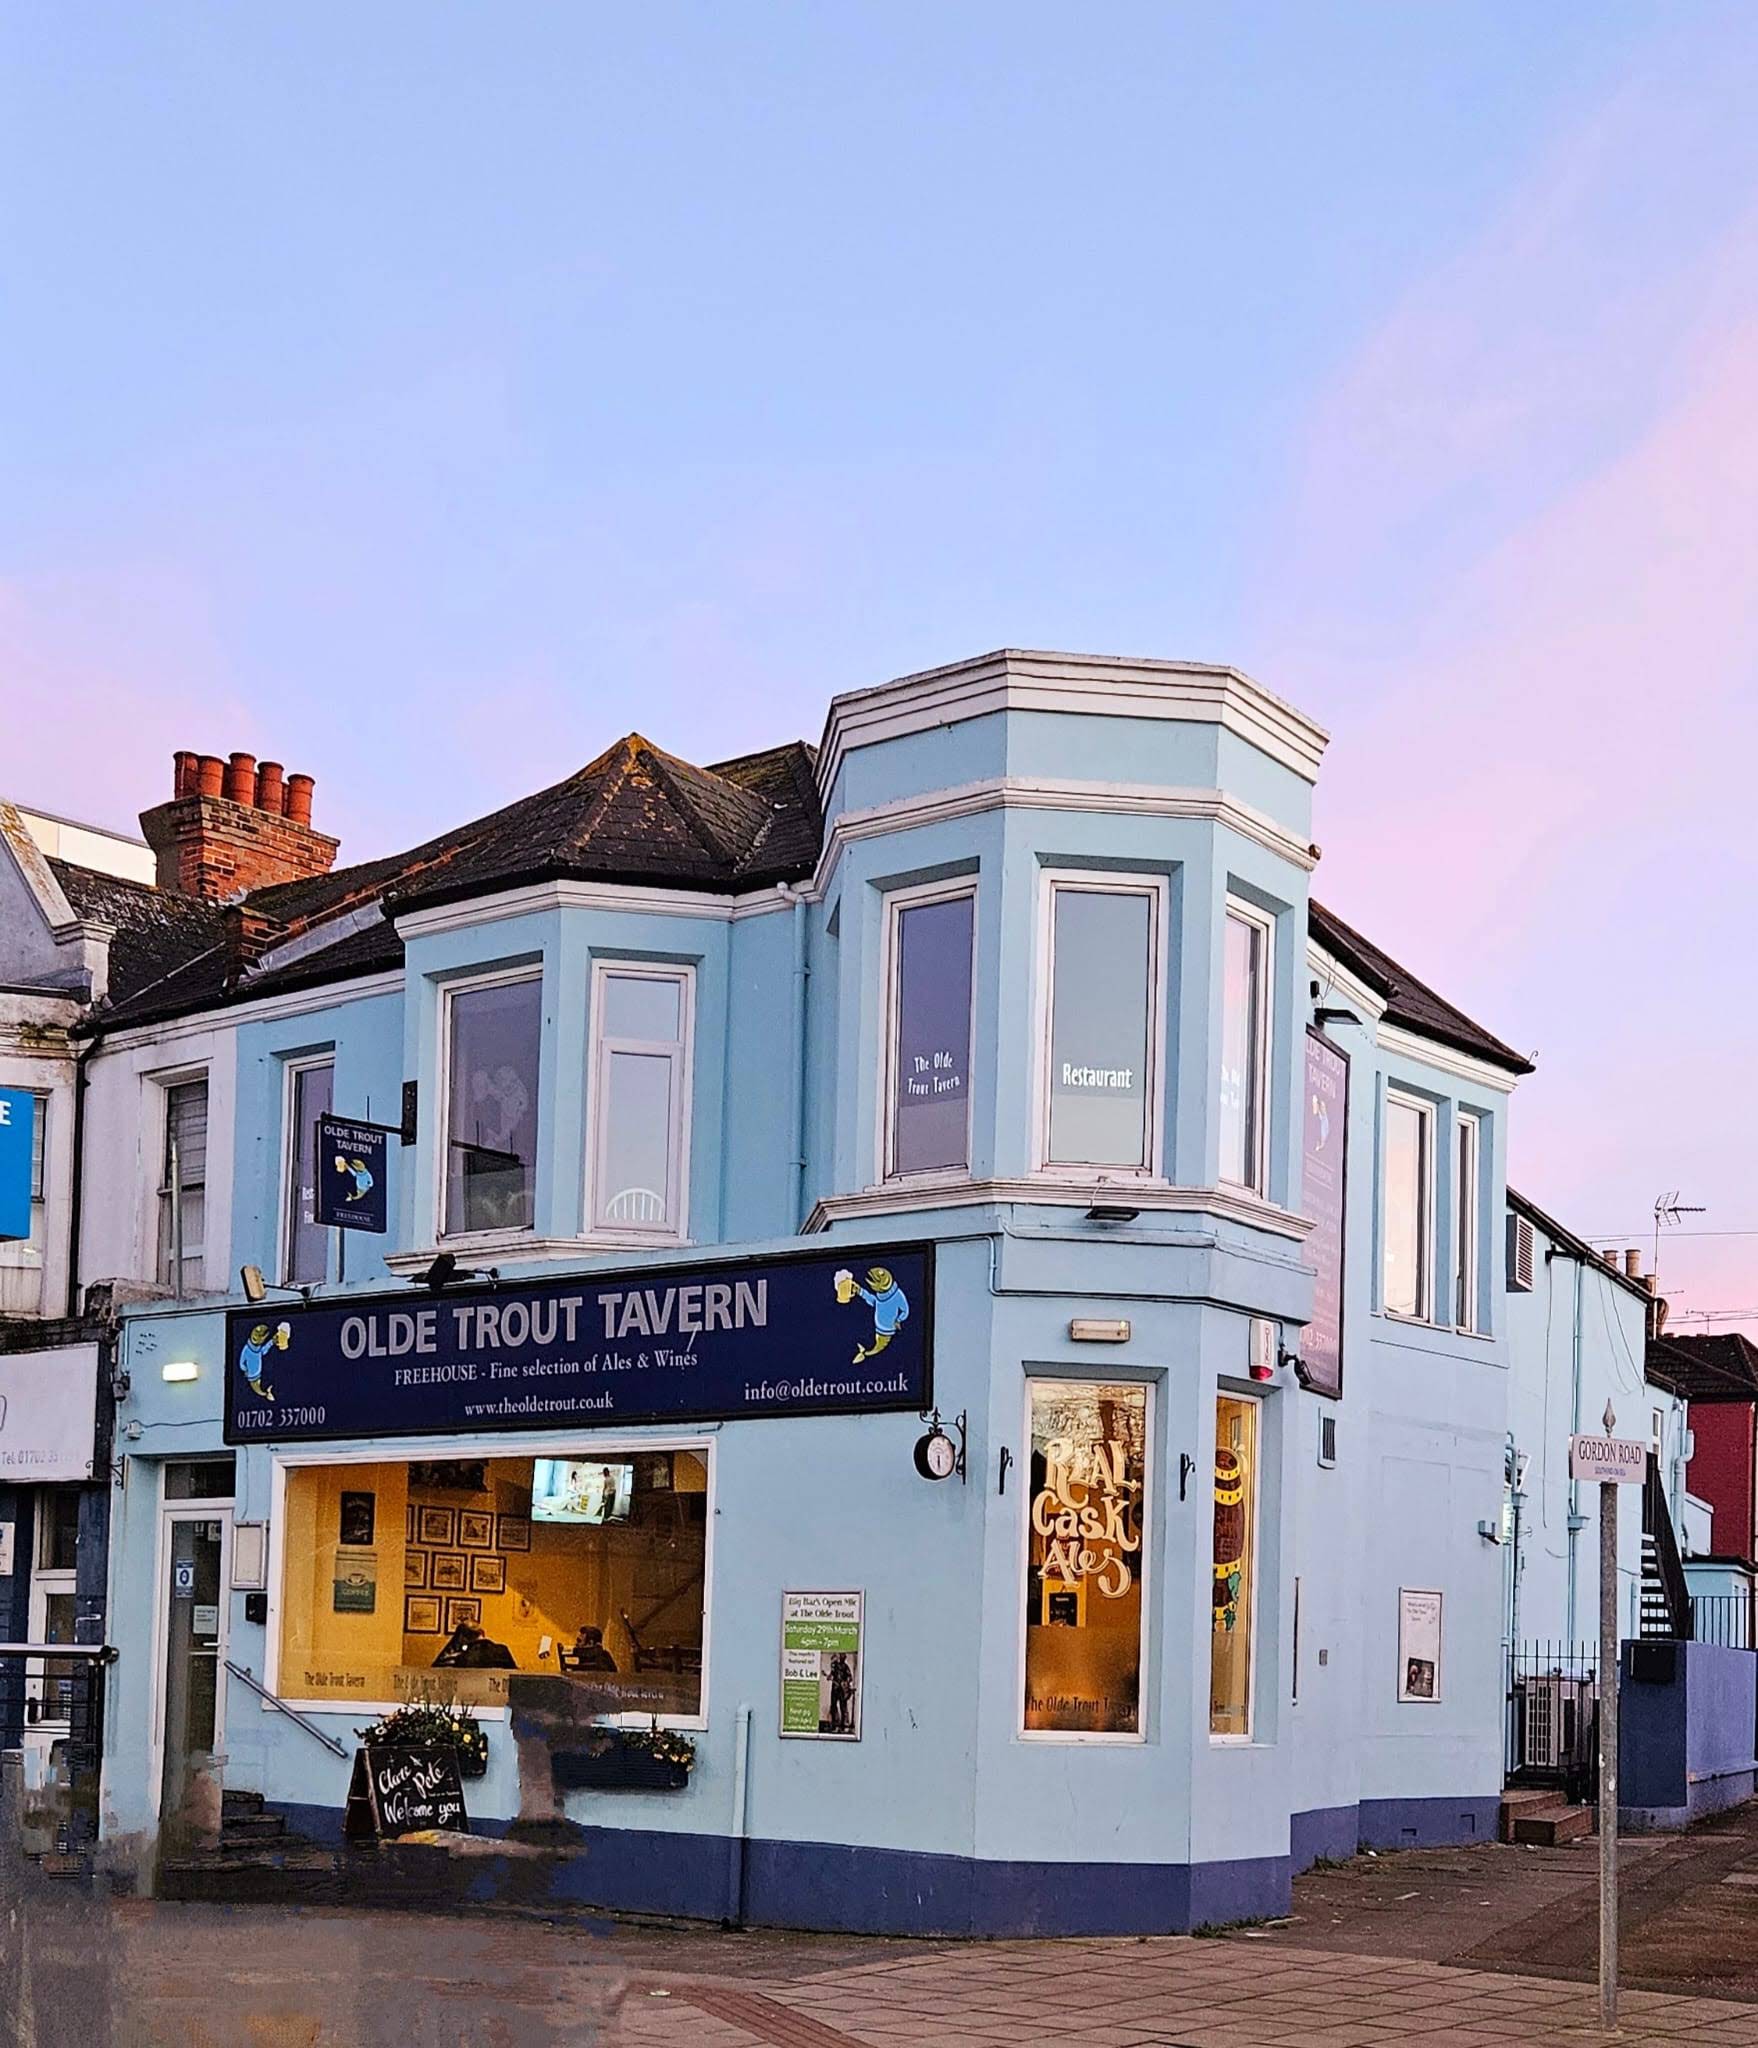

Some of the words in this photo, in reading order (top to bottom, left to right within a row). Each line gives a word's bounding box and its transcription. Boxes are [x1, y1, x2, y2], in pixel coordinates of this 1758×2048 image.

[914, 1056, 930, 1073] The
[933, 1051, 953, 1069] Olde
[907, 1077, 929, 1095] Trout
[933, 1075, 960, 1093] Tavern
[1062, 1063, 1133, 1089] Restaurant
[324, 1125, 350, 1139] OLDE
[352, 1130, 384, 1145] TROUT
[335, 1140, 373, 1155] TAVERN
[340, 1310, 437, 1360] OLDE
[452, 1296, 583, 1350] TROUT
[597, 1279, 768, 1340] TAVERN
[394, 1364, 478, 1386] FREEHOUSE
[489, 1362, 518, 1380] Fine
[522, 1358, 580, 1377] selection
[583, 1353, 599, 1373] of
[601, 1352, 632, 1371] Ales
[636, 1352, 650, 1369] &
[653, 1350, 698, 1368] Wines
[744, 1372, 909, 1401] info@oldetrout.co.uk
[464, 1390, 614, 1417] www.theoldetrout.co.uk
[237, 1409, 274, 1429] 01702
[278, 1406, 326, 1427] 337000
[1578, 1440, 1617, 1462] GORDON
[1618, 1443, 1642, 1465] ROAD
[1037, 1538, 1132, 1598] Ales
[800, 1609, 814, 1617] The
[814, 1609, 833, 1618] Olde
[834, 1609, 855, 1619] Trout
[785, 1624, 816, 1636] Saturday
[304, 1671, 315, 1687] The
[784, 1668, 798, 1678] Bob
[1046, 1696, 1070, 1712] Olde
[412, 1758, 448, 1800] Pete
[383, 1792, 434, 1826] Welcome
[437, 1801, 461, 1824] you
